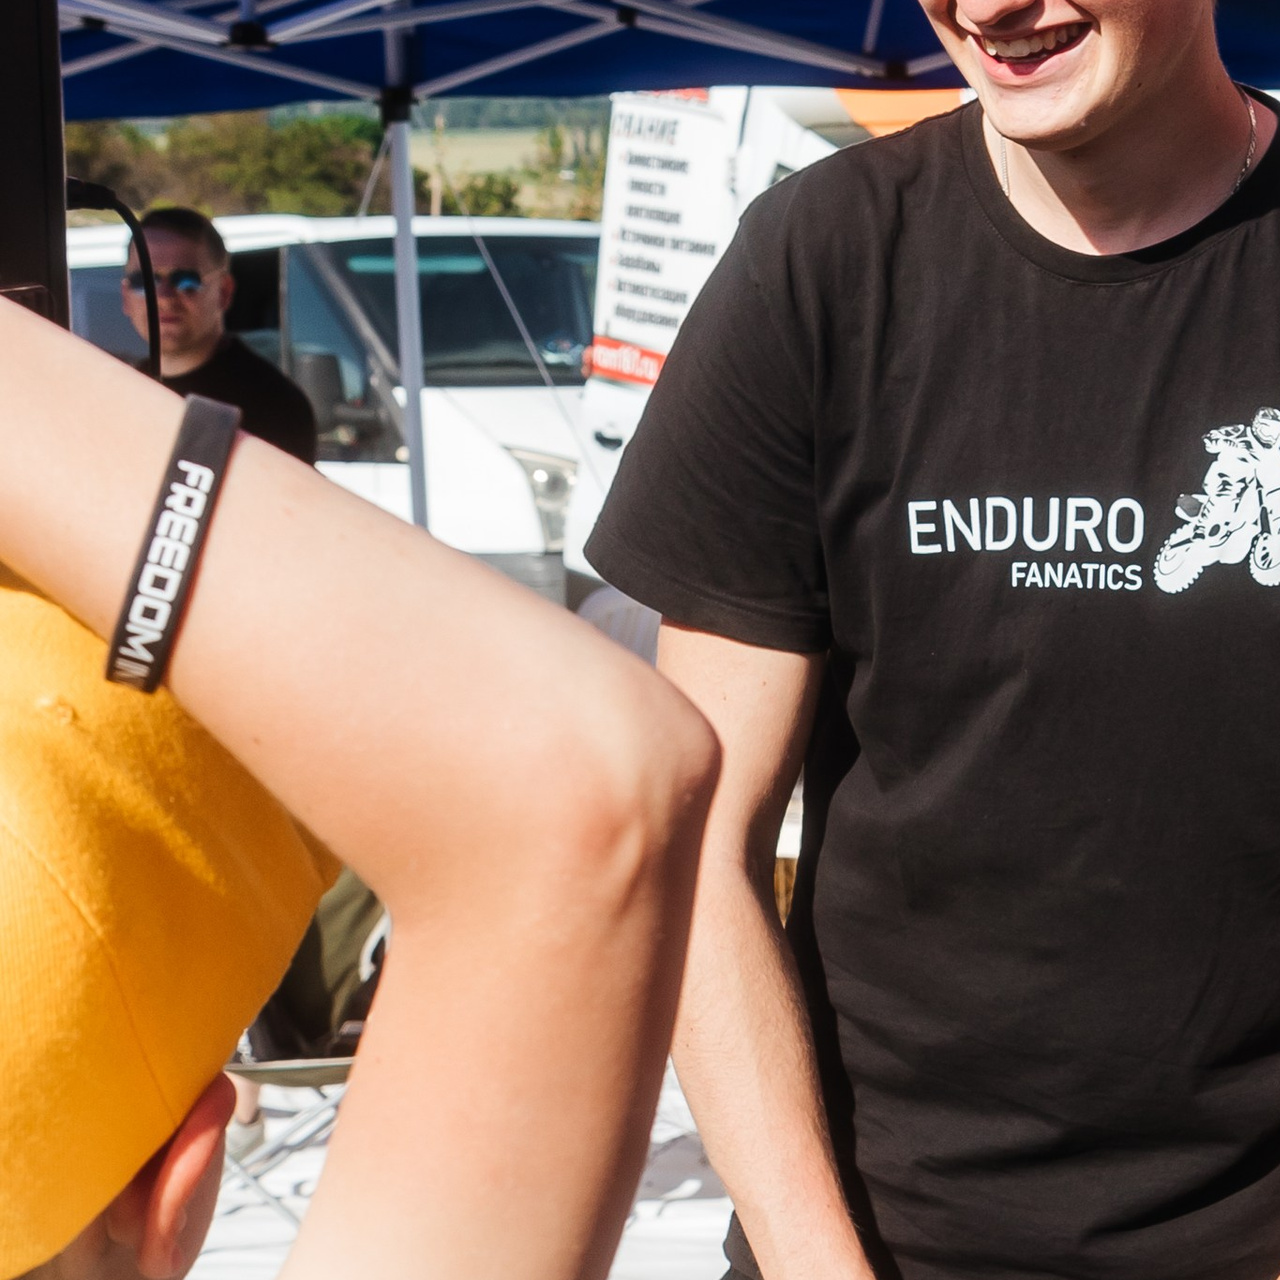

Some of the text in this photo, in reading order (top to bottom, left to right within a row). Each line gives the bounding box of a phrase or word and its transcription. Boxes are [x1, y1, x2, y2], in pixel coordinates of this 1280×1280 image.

[907, 497, 1145, 554] ENDURO
[119, 459, 215, 664] FREEDOM
[1011, 562, 1143, 591] FANATICS
